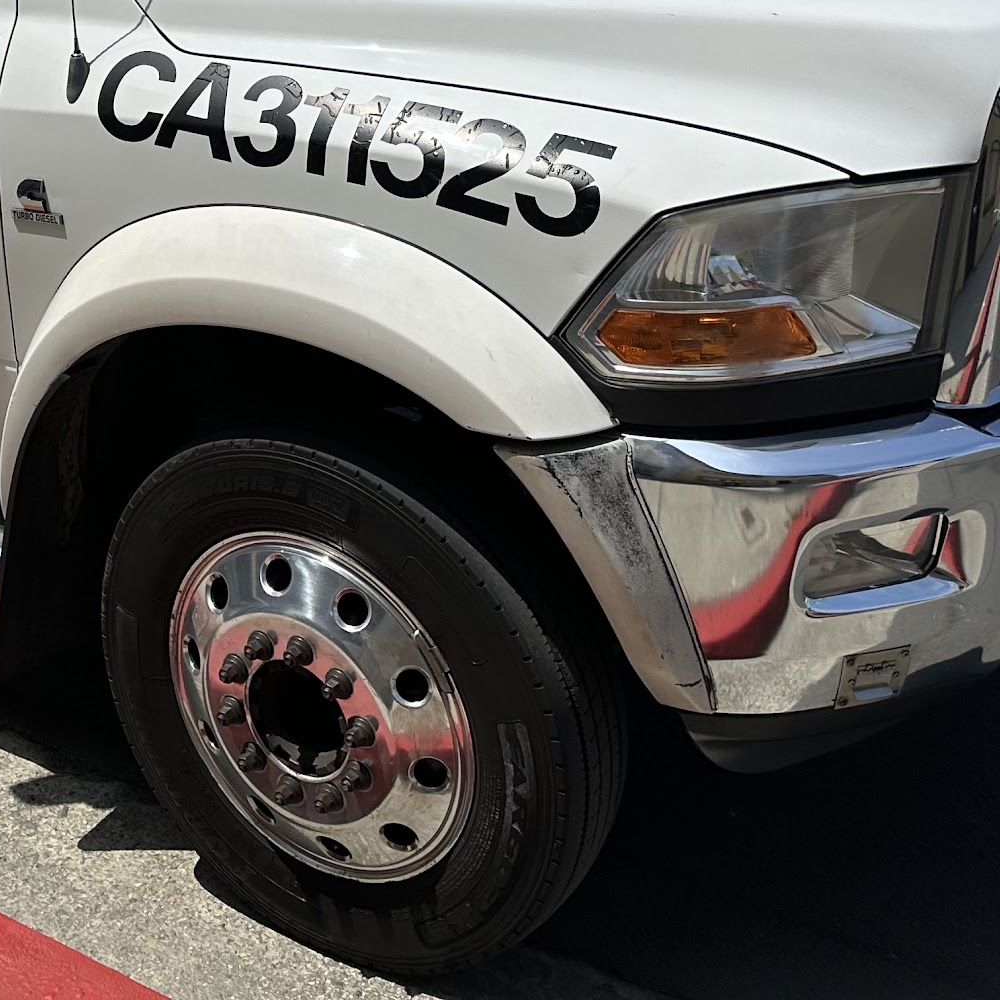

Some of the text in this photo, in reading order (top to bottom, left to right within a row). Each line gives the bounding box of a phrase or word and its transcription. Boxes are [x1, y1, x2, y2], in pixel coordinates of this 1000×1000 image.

[98, 50, 617, 238] CA311525
[12, 210, 58, 225] TURBO DIESEL
